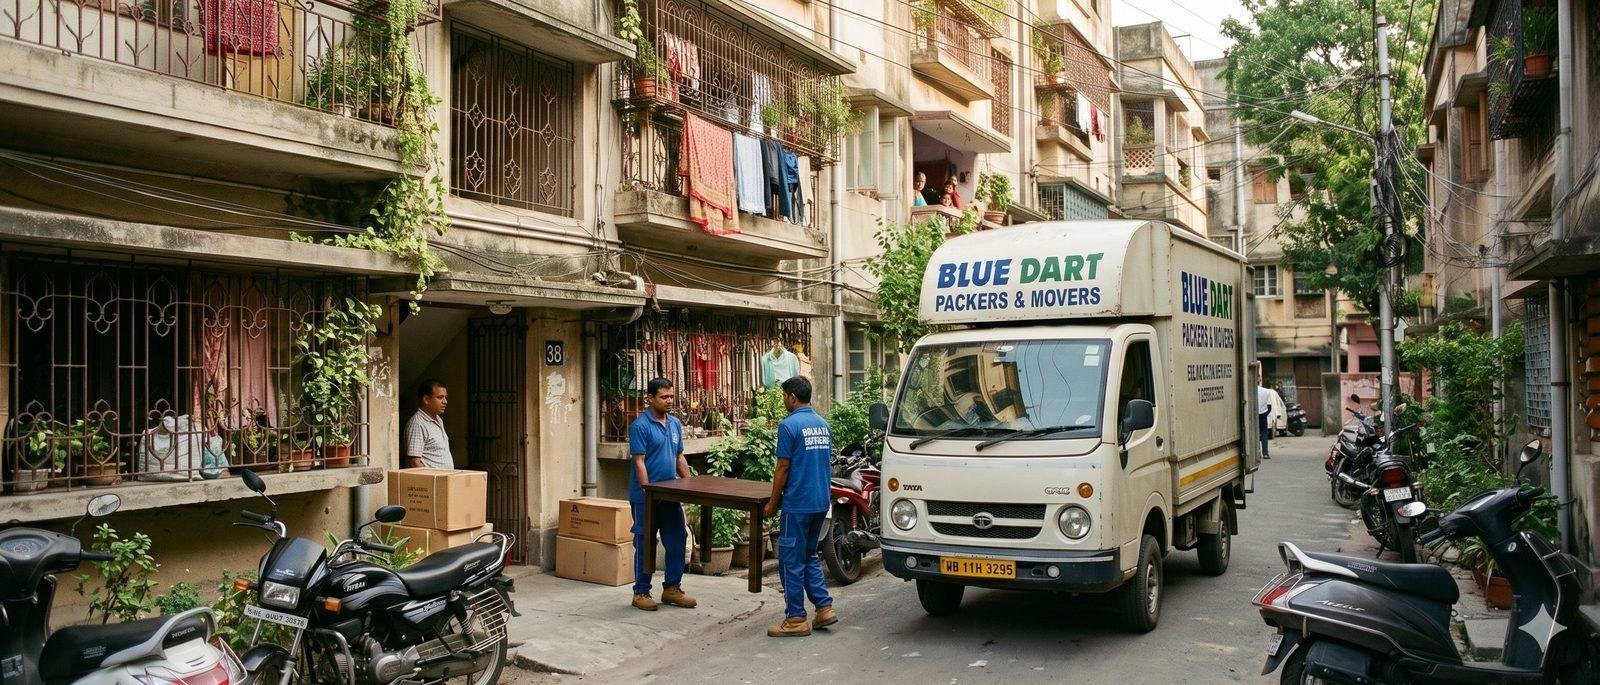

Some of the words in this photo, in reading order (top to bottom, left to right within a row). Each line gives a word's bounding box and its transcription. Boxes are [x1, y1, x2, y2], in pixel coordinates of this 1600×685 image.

[937, 258, 1012, 289] BLUE
[1019, 252, 1104, 284] DART
[935, 291, 1008, 312] PACKERS
[1014, 290, 1025, 309] &
[1031, 286, 1101, 307] MOVERS
[1181, 271, 1208, 316] BLUE
[1210, 280, 1233, 320] DART
[1182, 322, 1208, 348] PACKERS
[1214, 326, 1235, 349] MOVERS
[546, 344, 562, 363] 38
[946, 560, 959, 572] WB
[963, 562, 982, 573] 11H
[986, 563, 1013, 576] 3295
